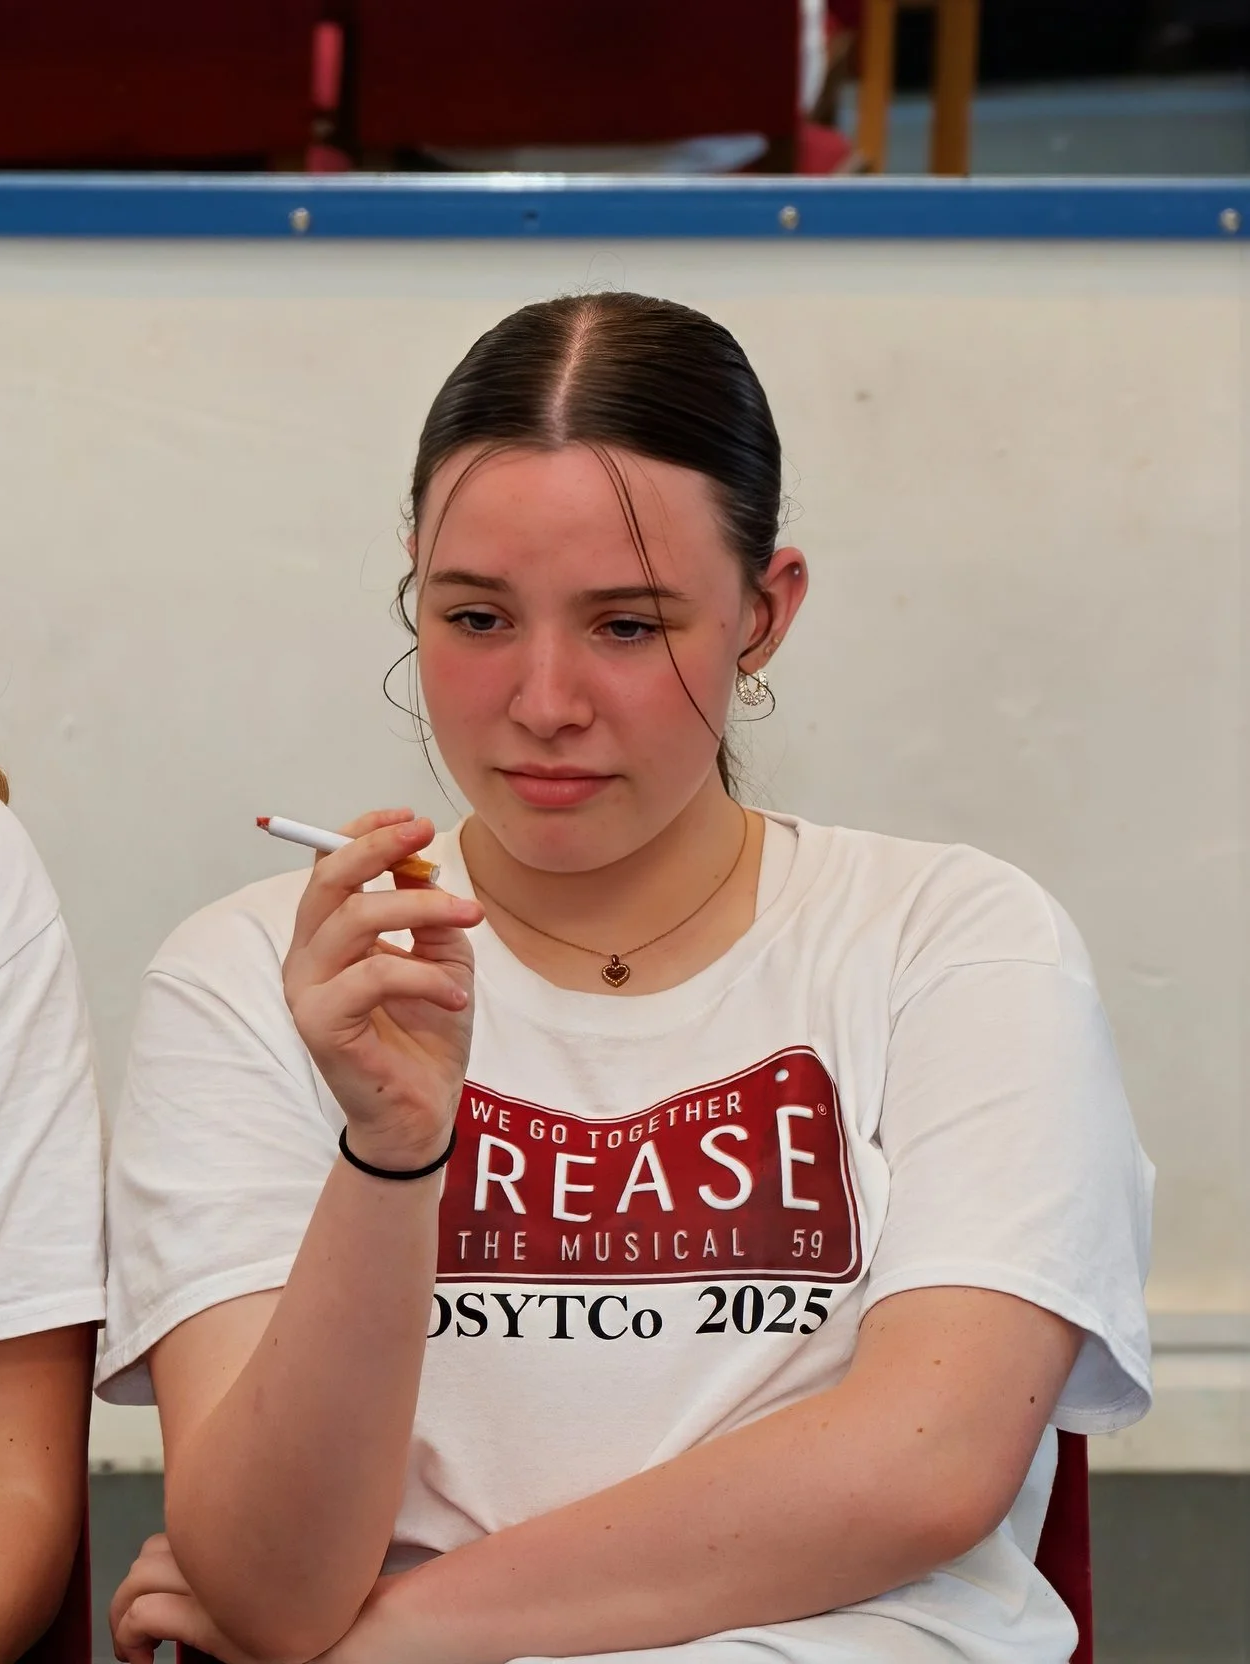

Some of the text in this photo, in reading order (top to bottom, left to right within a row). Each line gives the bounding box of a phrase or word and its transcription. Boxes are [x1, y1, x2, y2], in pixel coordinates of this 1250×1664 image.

[469, 1090, 743, 1149] WE GO TOGETHER
[474, 1104, 821, 1222] REASE
[458, 1228, 825, 1261] THE MUSICAL 59
[427, 1286, 833, 1340] OSYTCo 2025
